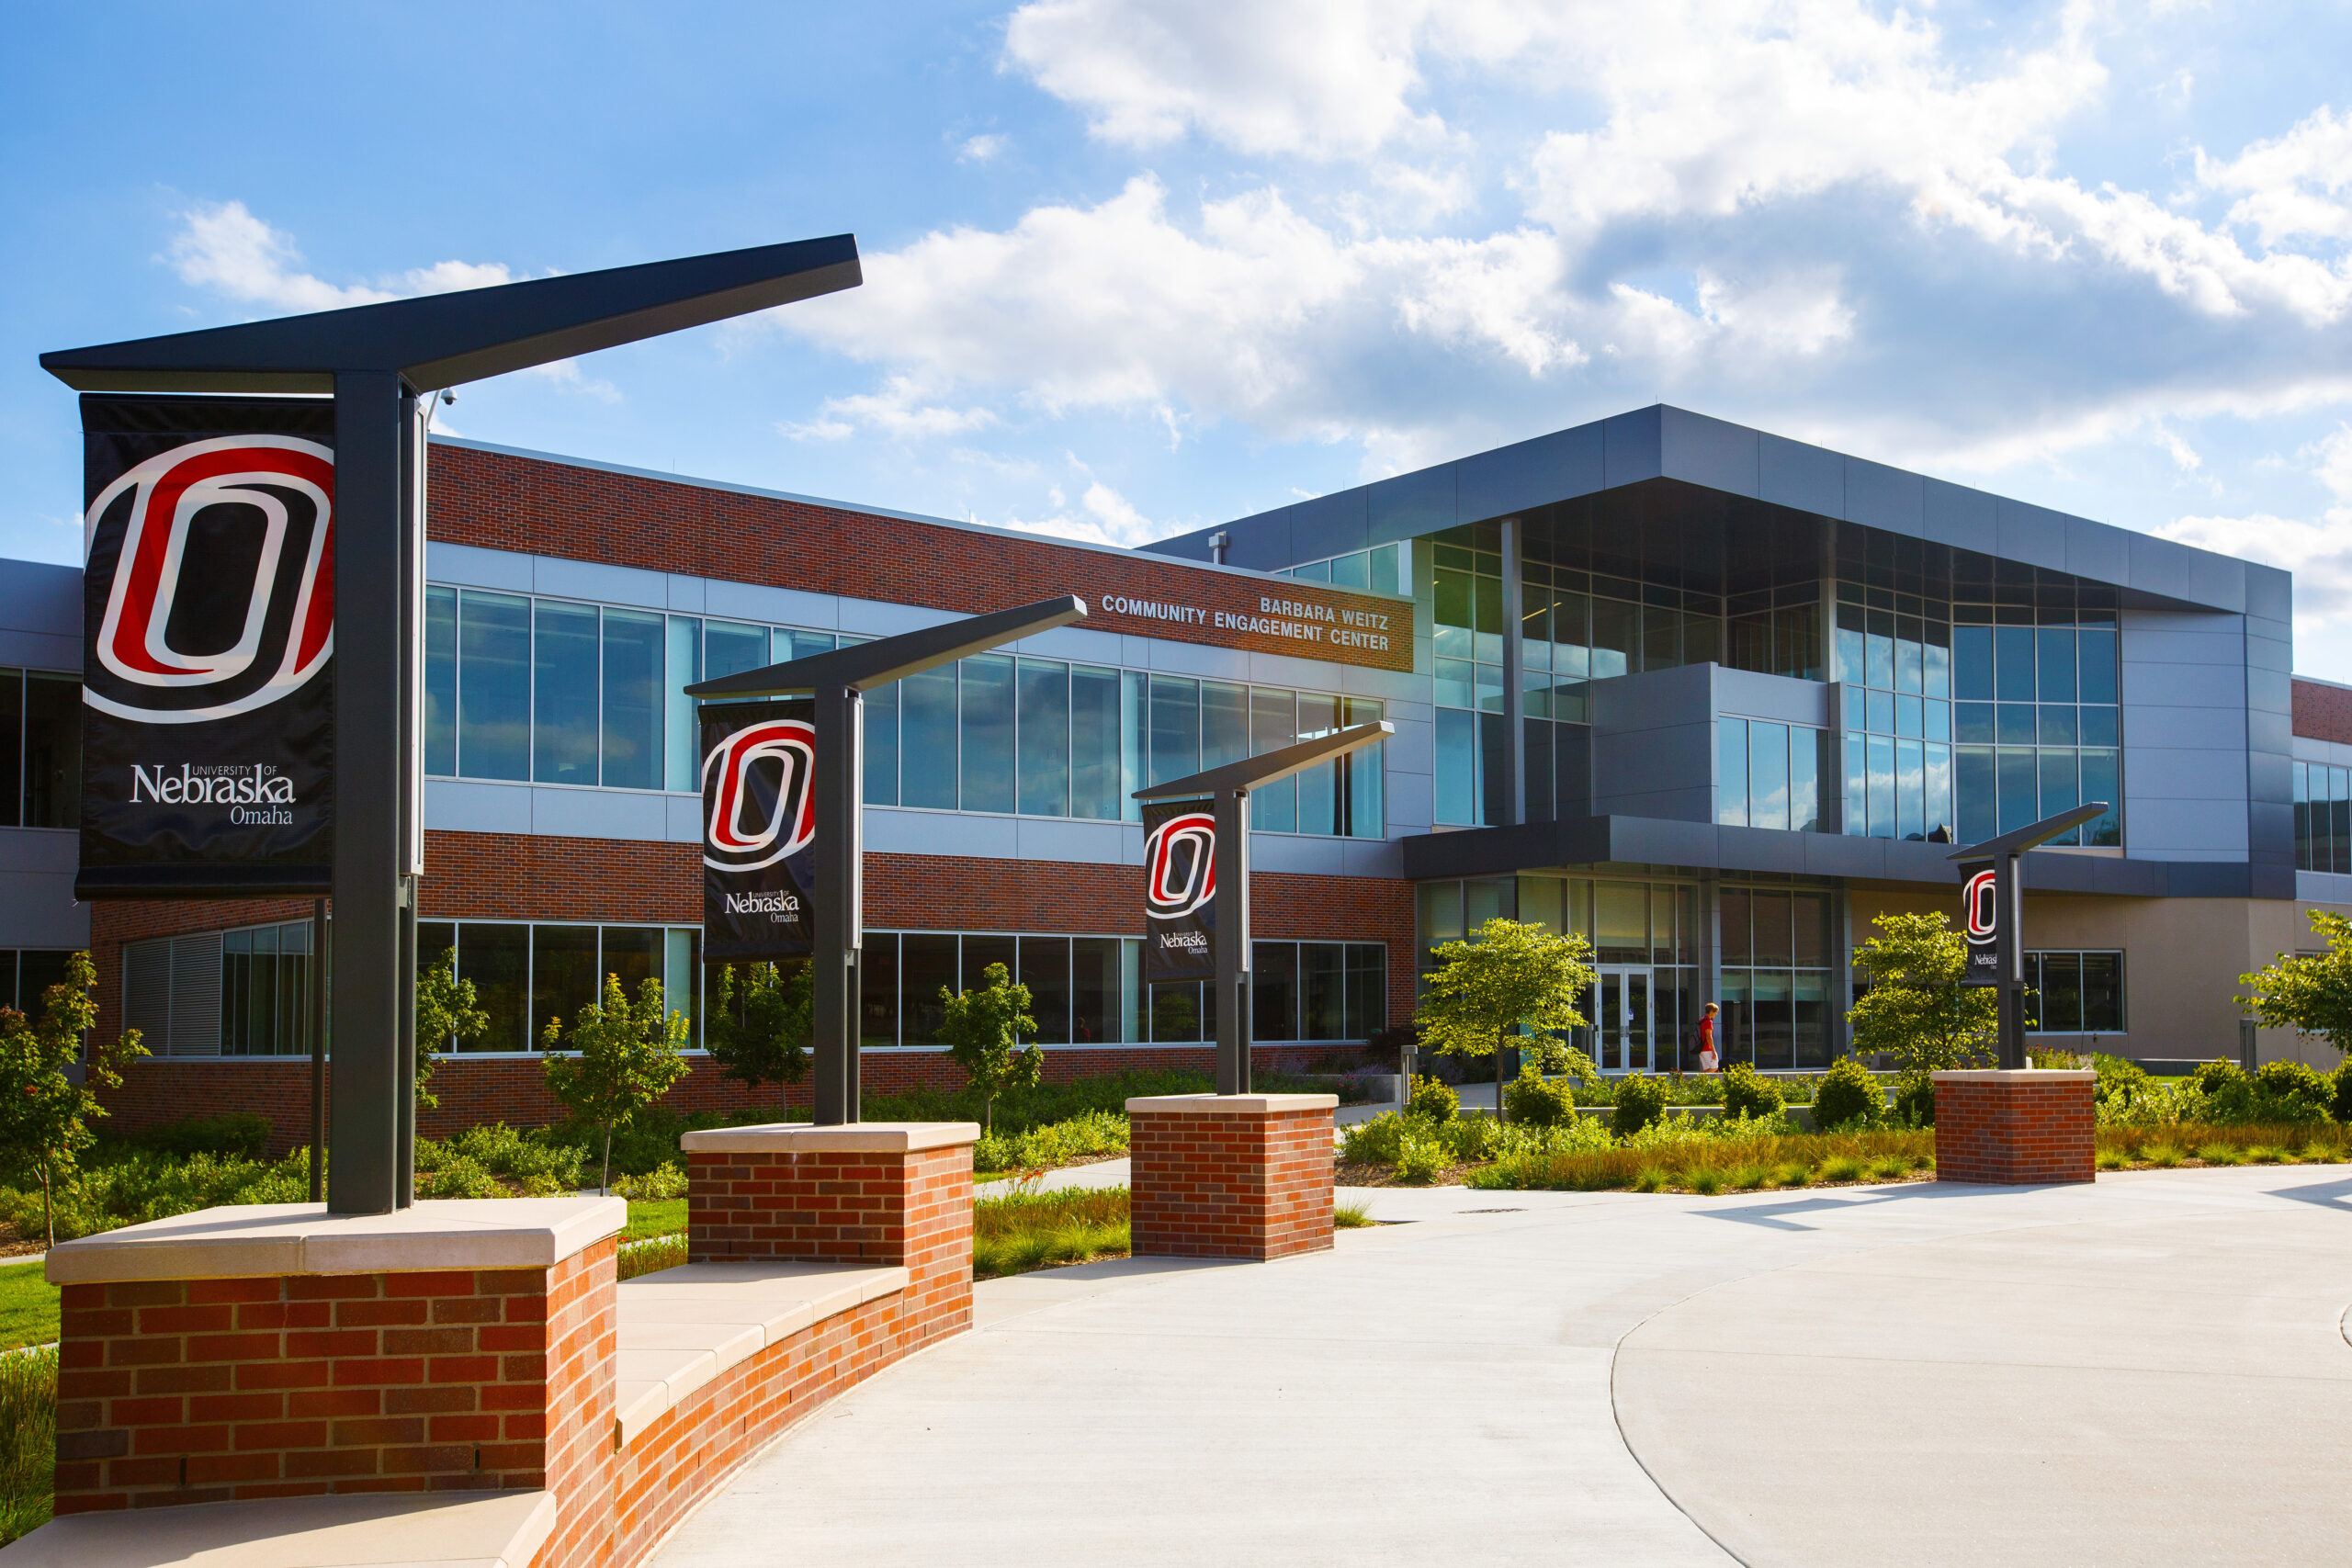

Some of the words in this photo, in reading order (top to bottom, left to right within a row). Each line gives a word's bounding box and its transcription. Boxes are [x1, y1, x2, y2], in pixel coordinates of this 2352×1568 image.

[1102, 594, 1206, 626] COMMUNITY
[1215, 611, 1323, 642] ENGAGEMENT
[1330, 628, 1389, 651] CENTER
[1261, 597, 1336, 623] BARBARA
[1341, 609, 1389, 631] WEITZ
[192, 765, 252, 776] UNIVERSITY
[264, 765, 277, 776] OF
[129, 762, 297, 804] Nebraska
[231, 806, 293, 825] Omaha
[724, 889, 800, 914] Nebraska
[771, 911, 798, 923] Omaha
[1159, 931, 1207, 948] Nebraska
[1974, 953, 1997, 965] Nebras
